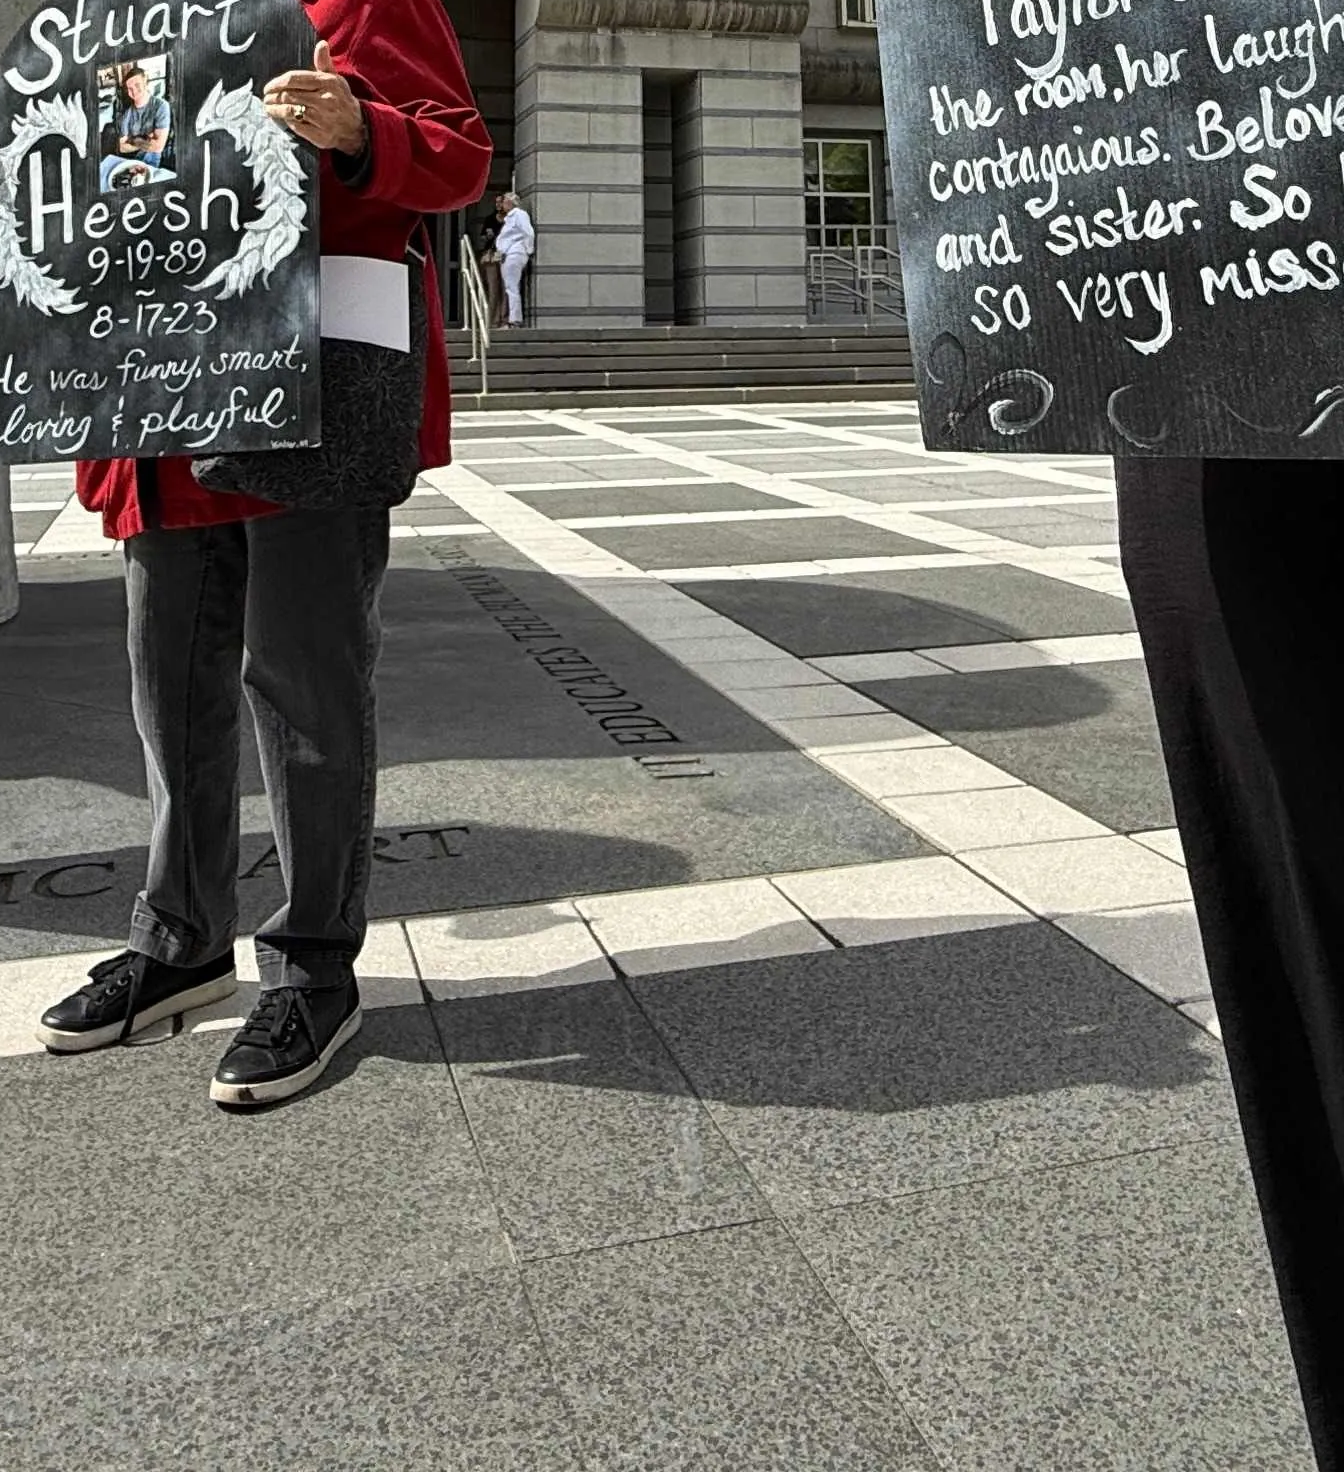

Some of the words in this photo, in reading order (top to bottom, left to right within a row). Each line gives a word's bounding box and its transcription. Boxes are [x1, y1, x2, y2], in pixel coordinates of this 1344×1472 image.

[929, 85, 1003, 136] the
[29, 139, 240, 255] Heesh
[929, 125, 1171, 219] contagaious.
[935, 214, 1023, 273] and
[1045, 186, 1202, 257] sister.
[1229, 163, 1312, 230] So
[89, 238, 207, 287] 9-19-89
[89, 300, 218, 340] 8-17-23
[971, 283, 1032, 336] so
[1056, 269, 1174, 356] very
[50, 369, 108, 393] was
[210, 334, 308, 374] smart,
[139, 385, 297, 450] playful.
[495, 614, 561, 643] THE
[527, 646, 682, 746] EDUCATES
[632, 755, 715, 779] IT
